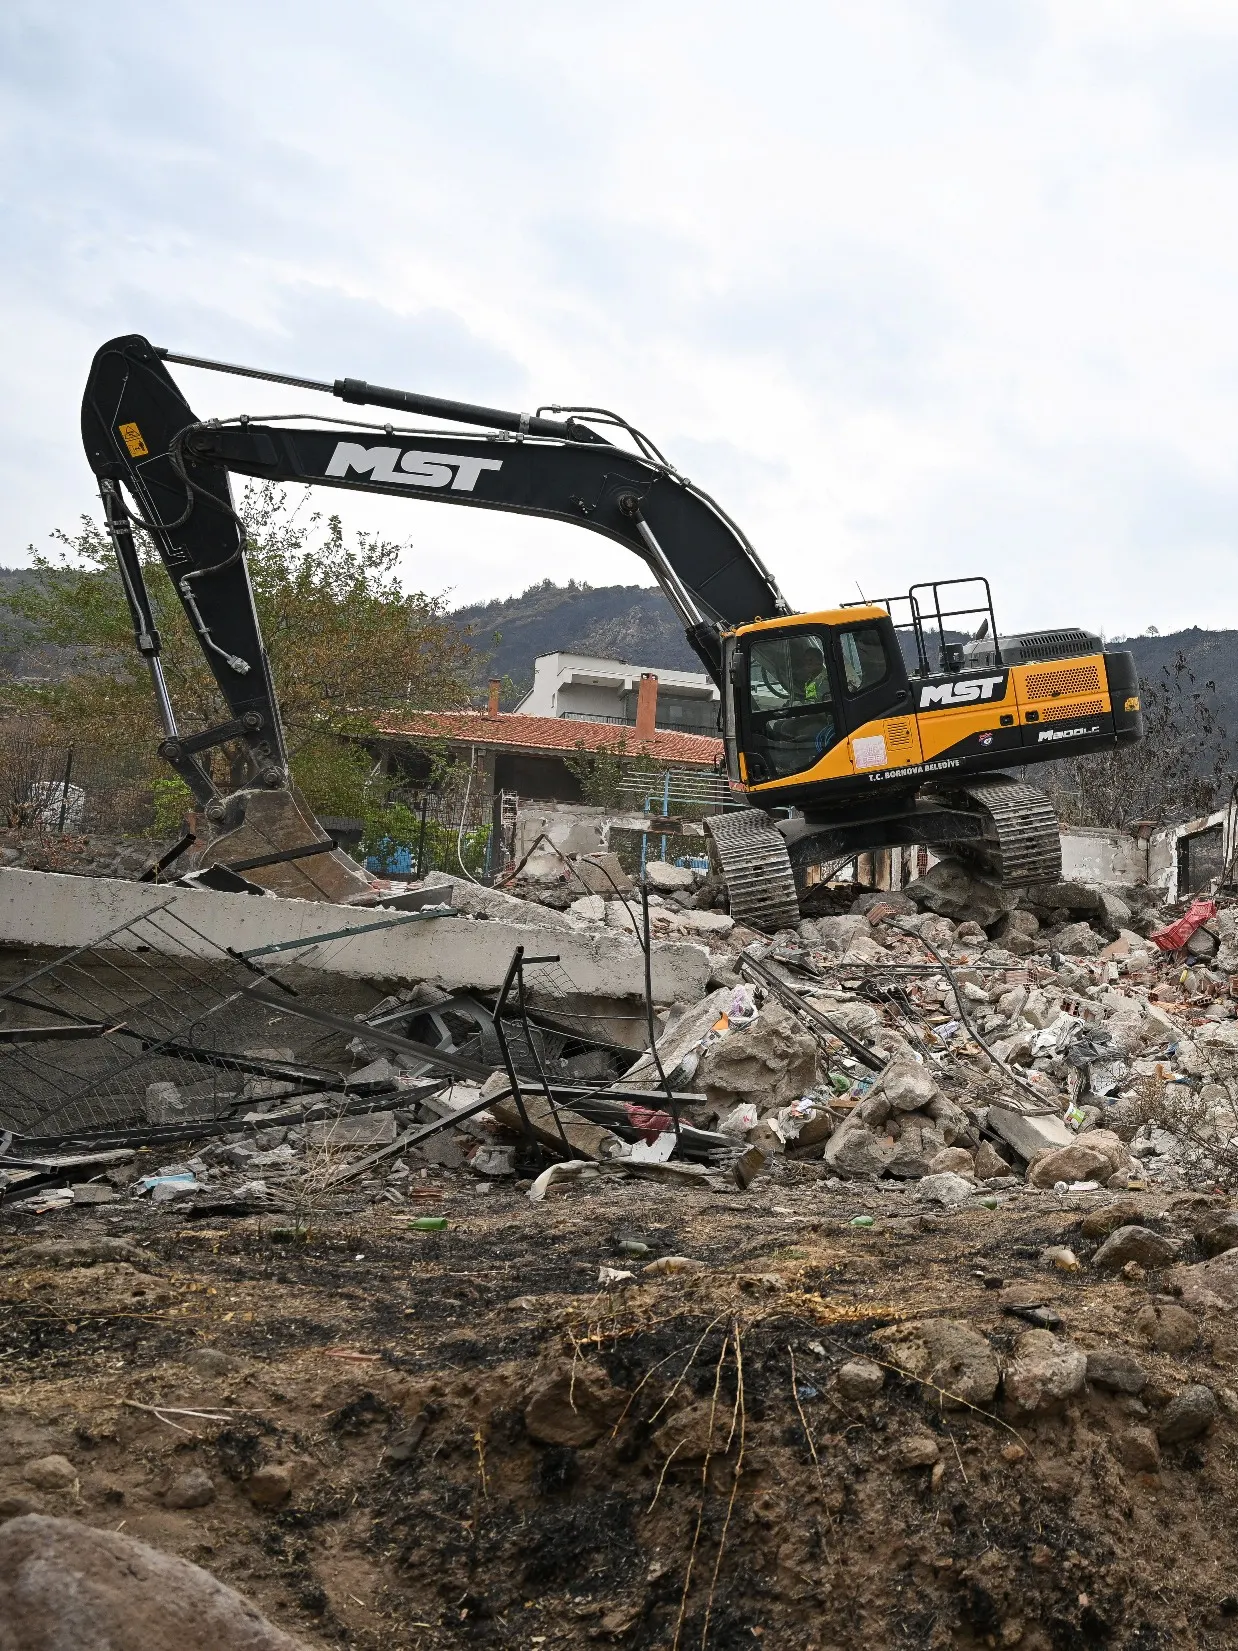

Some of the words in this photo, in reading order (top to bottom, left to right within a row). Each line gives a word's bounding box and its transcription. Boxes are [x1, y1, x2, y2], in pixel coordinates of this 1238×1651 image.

[324, 441, 503, 492] MST
[919, 675, 1004, 708] MST
[868, 773, 884, 782] T.C.
[884, 764, 924, 780] BORNOVA
